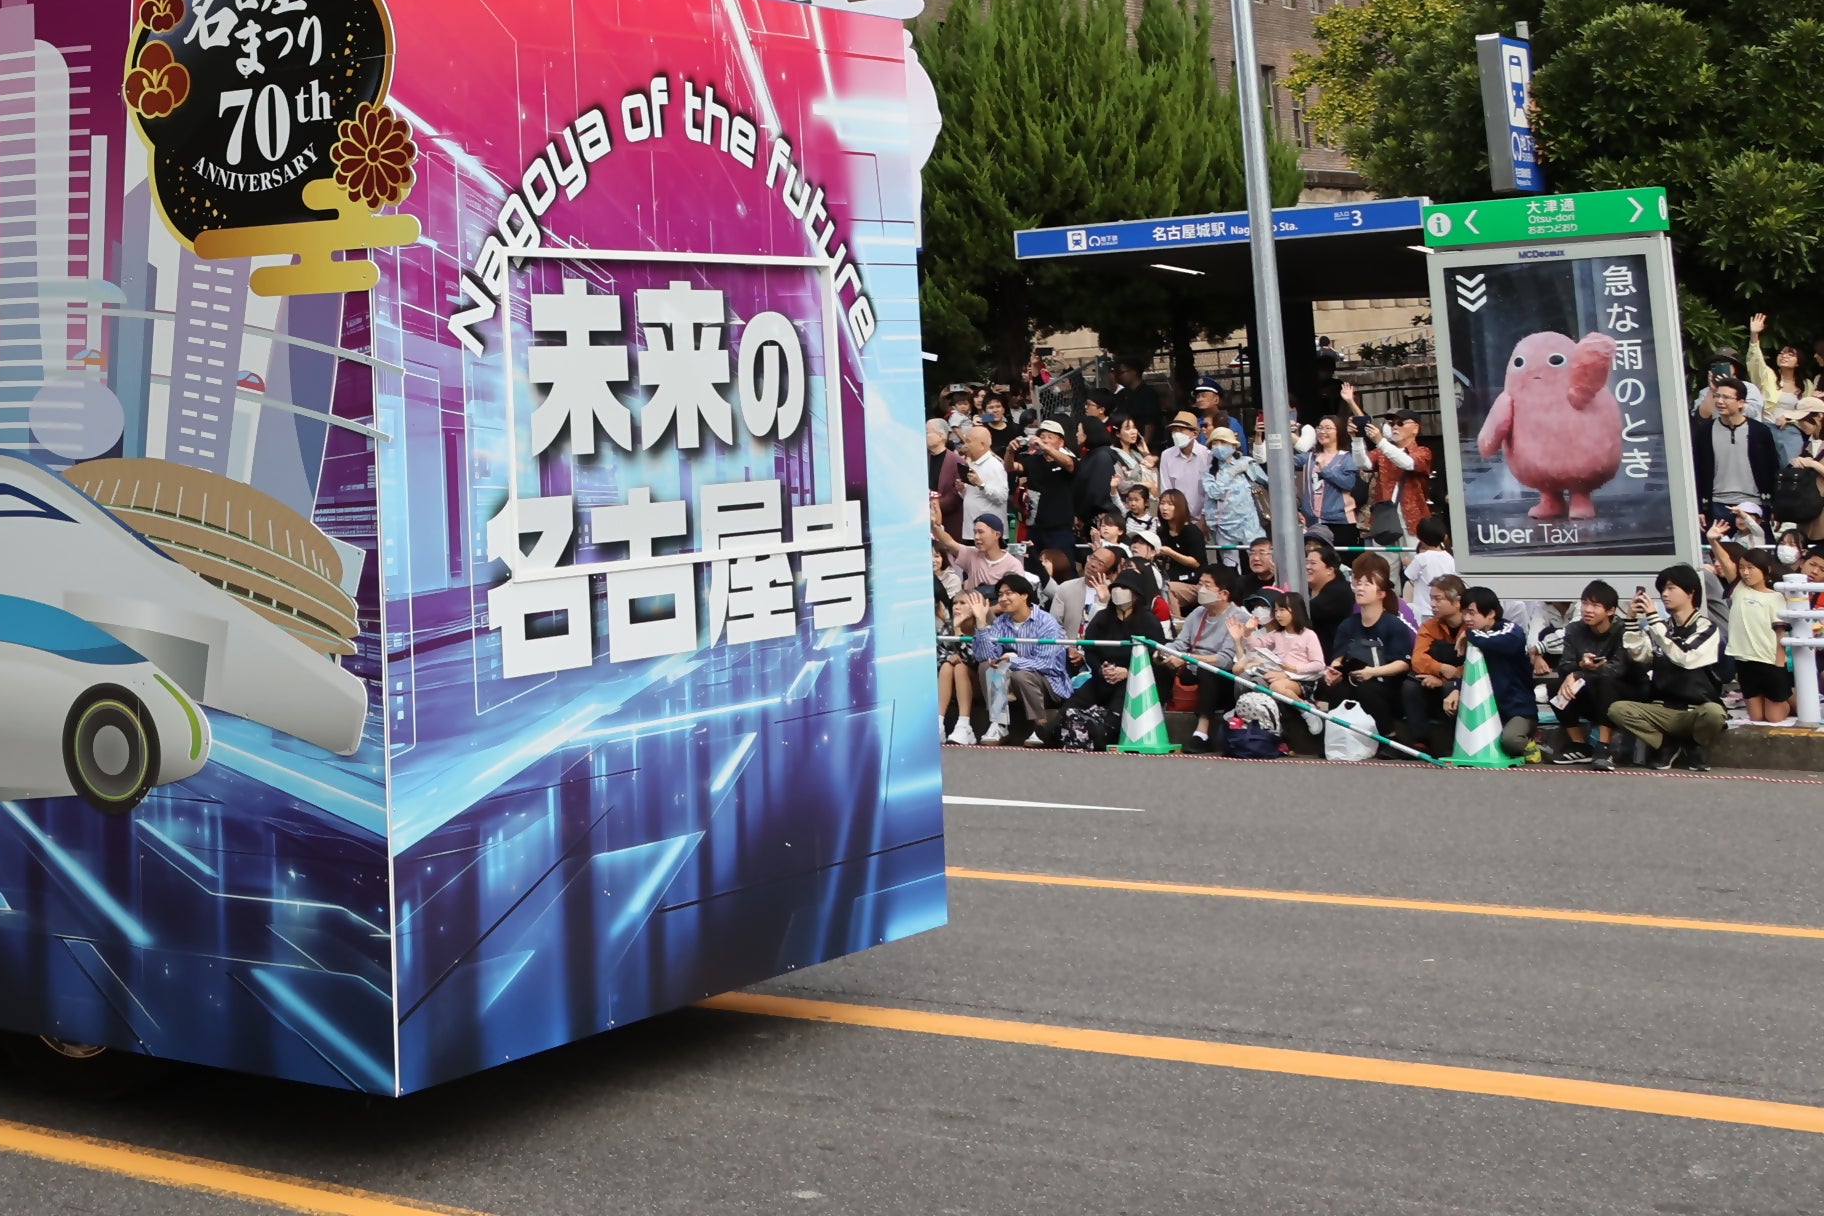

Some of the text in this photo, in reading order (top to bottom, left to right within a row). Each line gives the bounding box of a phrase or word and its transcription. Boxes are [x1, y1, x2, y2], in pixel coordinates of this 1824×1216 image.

[233, 14, 324, 77] まつり
[217, 79, 334, 167] 70th
[191, 143, 320, 193] ANNIVERSARY
[446, 77, 878, 360] Nagoya of the future
[1350, 209, 1364, 227] 3
[1526, 197, 1575, 214] 大津通
[1528, 212, 1575, 224] Otsu-dori
[1152, 221, 1226, 242] 名古屋城駅
[1279, 221, 1299, 232] Sta.
[1527, 223, 1578, 235] おおつどおり
[527, 277, 806, 458] 未来の
[1602, 264, 1653, 480] 急な雨のとき
[1477, 523, 1579, 544] Uber Taxi
[485, 479, 868, 679] 名古屋号
